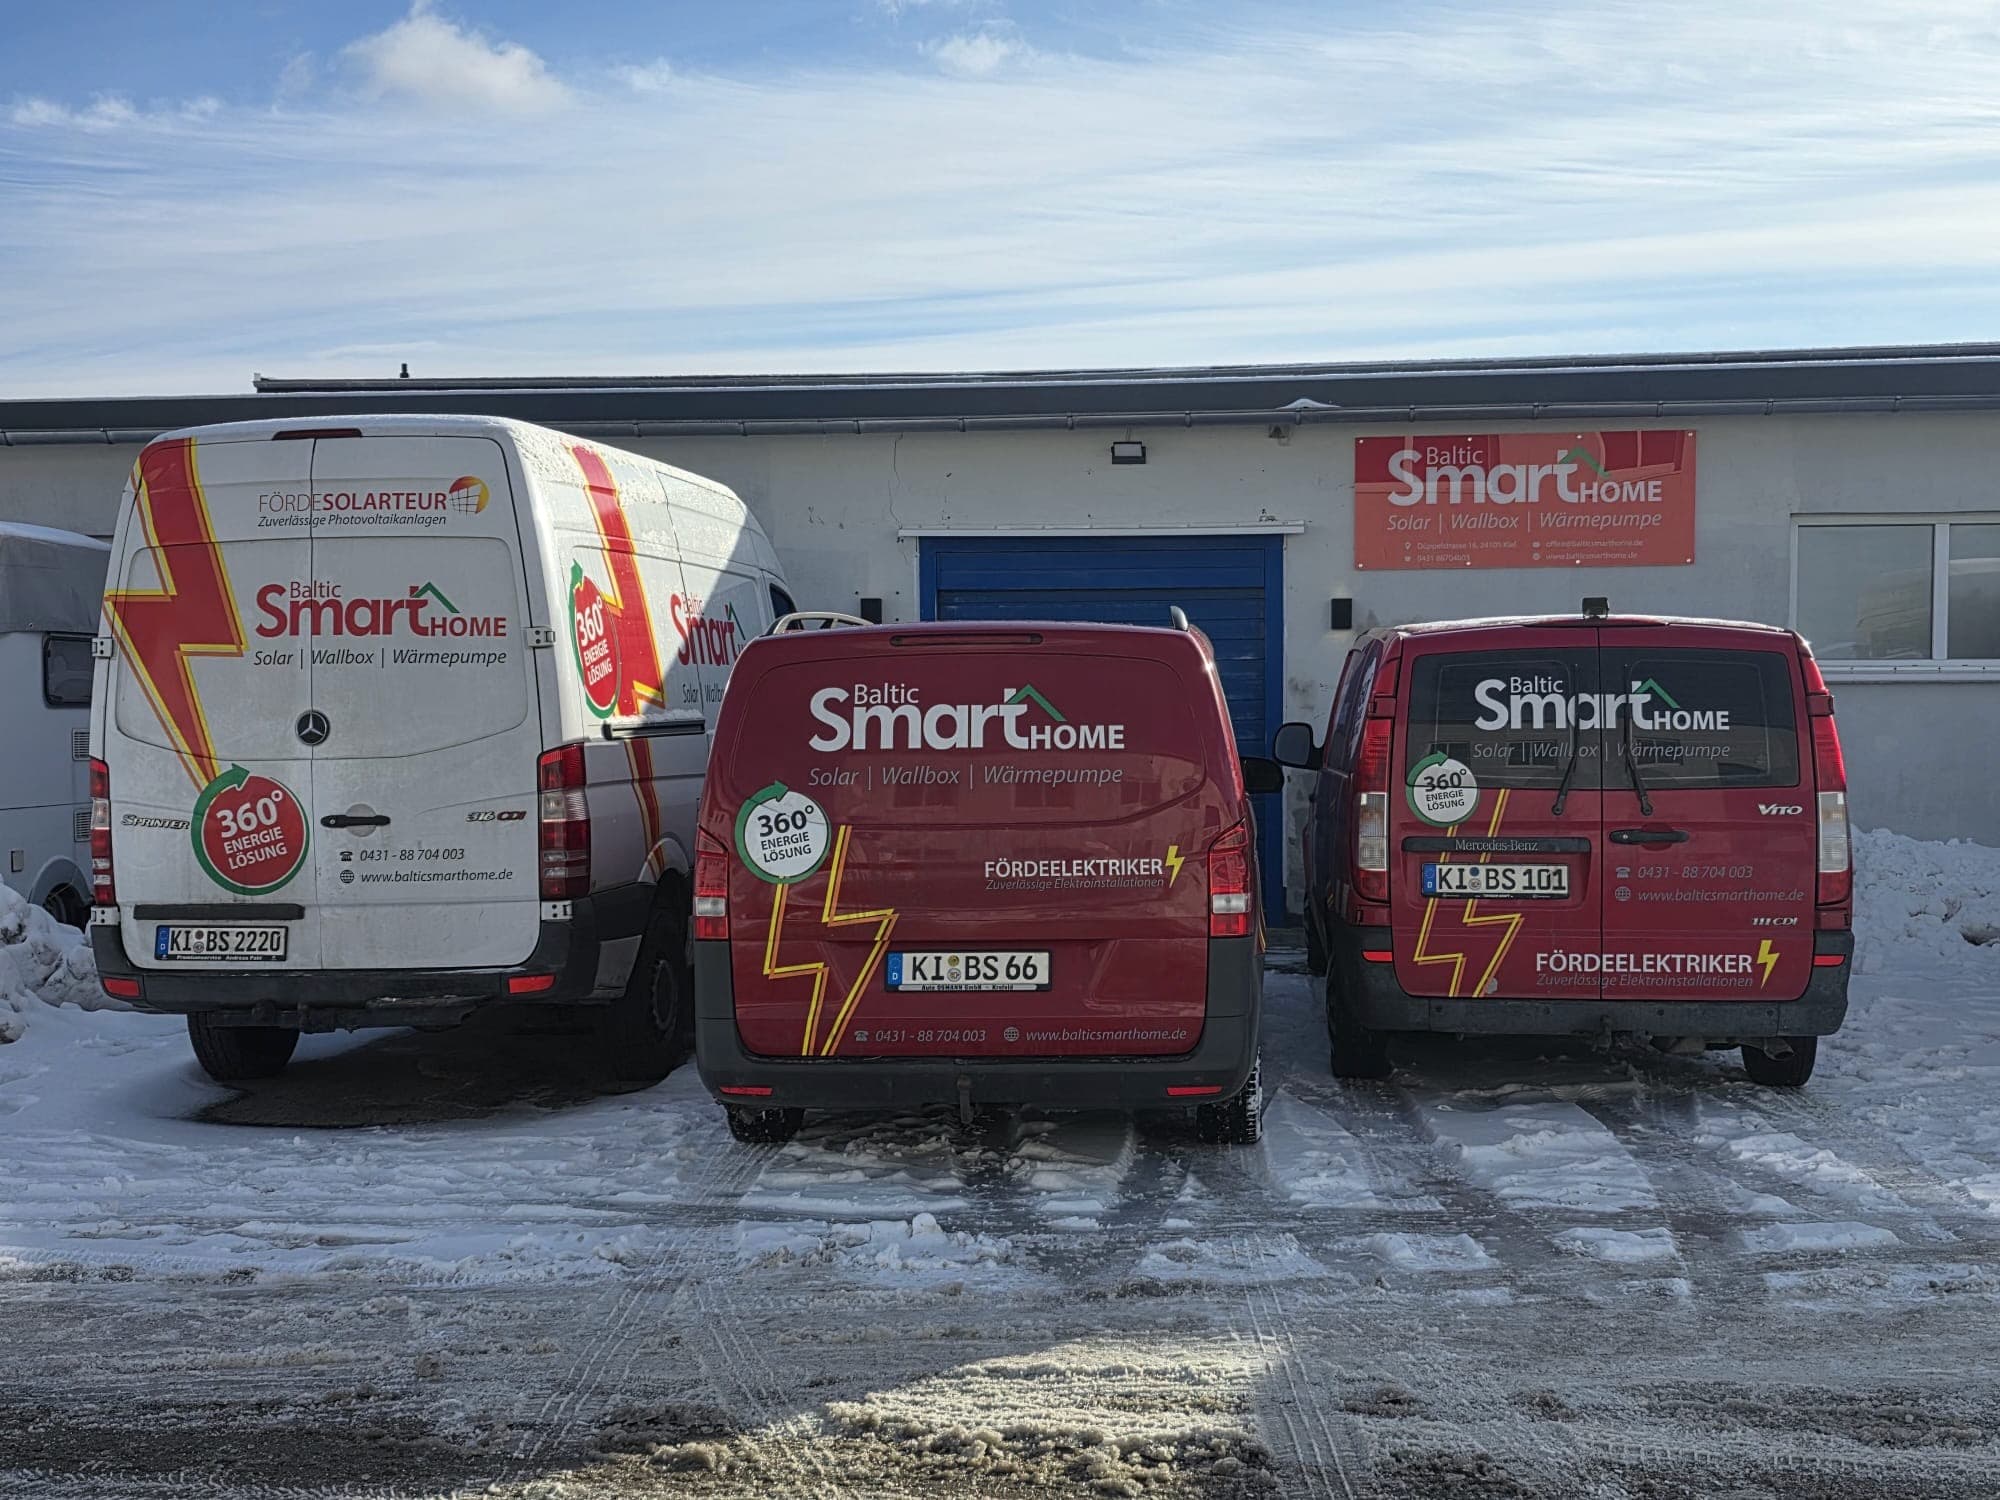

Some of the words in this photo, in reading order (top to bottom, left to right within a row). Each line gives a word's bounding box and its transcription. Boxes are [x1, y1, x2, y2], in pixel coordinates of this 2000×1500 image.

[1426, 446, 1484, 465] Baltic
[259, 491, 447, 513] FÖRDESOLARTEUR
[258, 514, 326, 528] Zuverlässige
[327, 513, 447, 527] Photovoltaikanlagen
[1387, 514, 1431, 531] Solar
[1451, 512, 1520, 530] Wallbox
[1539, 512, 1663, 531] Wärmepumpe
[290, 580, 342, 598] Baltic
[575, 595, 605, 647] 360°
[254, 650, 293, 666] Solar
[311, 648, 375, 665] Wallbox
[393, 648, 507, 668] Wärmepumpe
[587, 657, 613, 686] LÖSUNG
[853, 683, 919, 705] Baltic
[1510, 676, 1563, 693] Baltic
[1473, 743, 1515, 758] Solar
[808, 766, 859, 786] Solar
[882, 765, 960, 785] Wallbox
[983, 764, 1123, 788] Wärmepumpe
[1423, 768, 1467, 792] 360°
[1426, 789, 1464, 802] ENERGIE
[1427, 798, 1465, 811] LÖSUNG
[216, 790, 284, 838] 360°
[757, 805, 814, 837] 360°
[223, 827, 284, 855] ENERGIE
[760, 831, 810, 850] ENERGIE
[1455, 839, 1538, 851] Mercedes-Benz
[228, 842, 288, 870] LÖSUNG
[360, 850, 388, 861] 0431
[400, 850, 414, 861] 88
[417, 849, 439, 861] 704
[442, 848, 465, 860] 003
[763, 843, 812, 863] LÖSUNG
[360, 868, 513, 883] www.balticsmarthome.de
[984, 857, 1163, 878] FÖRDEELEKTRIKER
[1638, 866, 1669, 879] 0431
[1681, 866, 1698, 879] 88
[1701, 866, 1725, 879] 704
[1728, 865, 1753, 878] 003
[985, 879, 1051, 891] Zuverlässige
[1054, 877, 1164, 889] Elektroinstallationen
[1438, 868, 1467, 890] KI
[1485, 868, 1516, 890] BS
[1522, 868, 1566, 890] 101
[1638, 888, 1805, 902] www.balticsmarthome.de
[1752, 917, 1771, 926] 111
[1772, 917, 1798, 926] CDI
[170, 930, 192, 951] KI
[206, 930, 230, 952] BS
[234, 930, 281, 952] 2220
[912, 956, 944, 981] KI
[964, 955, 999, 981] BS
[1005, 955, 1038, 981] 66
[1536, 949, 1752, 973] FÖRDEELEKTRIKER
[1536, 973, 1617, 989] Zuverlässige
[1619, 973, 1753, 987] Elektroinstallationen
[875, 1030, 906, 1042] 0431
[917, 1030, 934, 1042] 88
[936, 1030, 960, 1042] 704
[962, 1029, 986, 1042] 003
[1026, 1028, 1187, 1042] www.balticsmarthome.de
